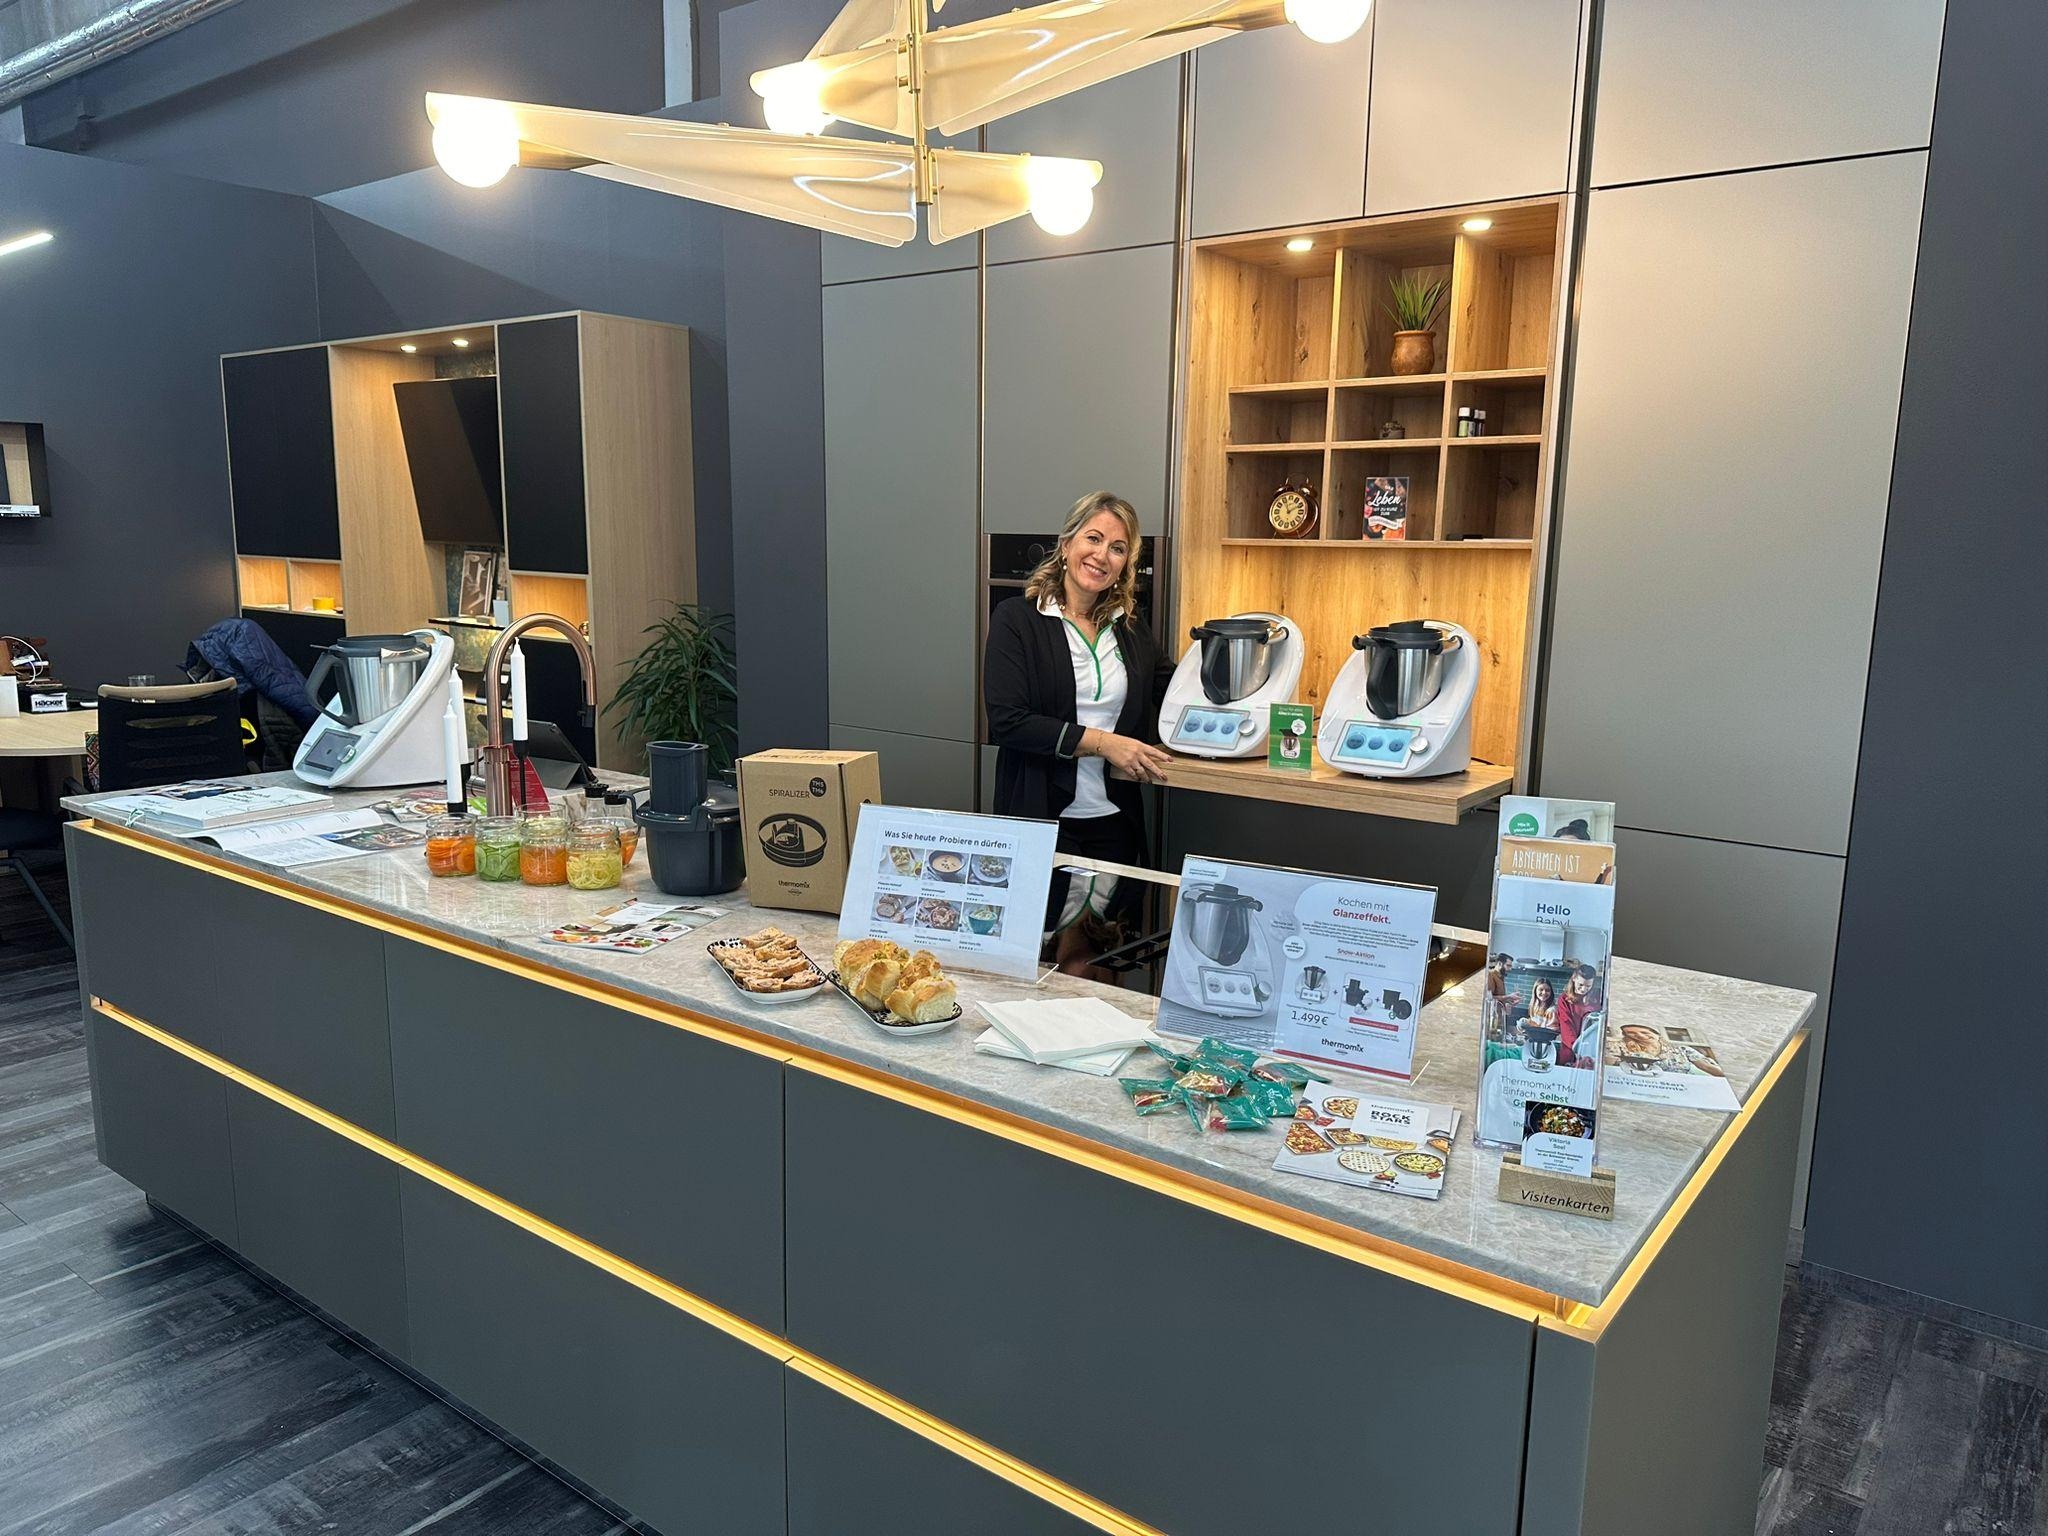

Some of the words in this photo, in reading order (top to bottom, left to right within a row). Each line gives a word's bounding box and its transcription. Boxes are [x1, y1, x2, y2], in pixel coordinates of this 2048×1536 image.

[1368, 490, 1401, 506] Leben
[768, 789, 810, 799] SPIRALIZER
[884, 830, 900, 839] Was
[901, 831, 913, 840] Sie
[914, 833, 936, 842] heute
[981, 840, 1007, 849] dürfen
[1512, 849, 1561, 872] ABNEHMEN
[1565, 854, 1581, 873] IST
[778, 880, 810, 889] thermomix
[1338, 896, 1372, 909] Kochen
[1374, 903, 1390, 911] mit
[1537, 903, 1571, 916] Hello
[1333, 908, 1391, 924] Glanzeffekt.
[1321, 1038, 1364, 1053] thermomix
[1503, 1086, 1536, 1098] Einfach
[1539, 1092, 1569, 1103] Selbst
[1370, 1115, 1411, 1125] STARS
[1371, 1110, 1411, 1121] ROCK
[1521, 1189, 1610, 1214] Visitenkarten
